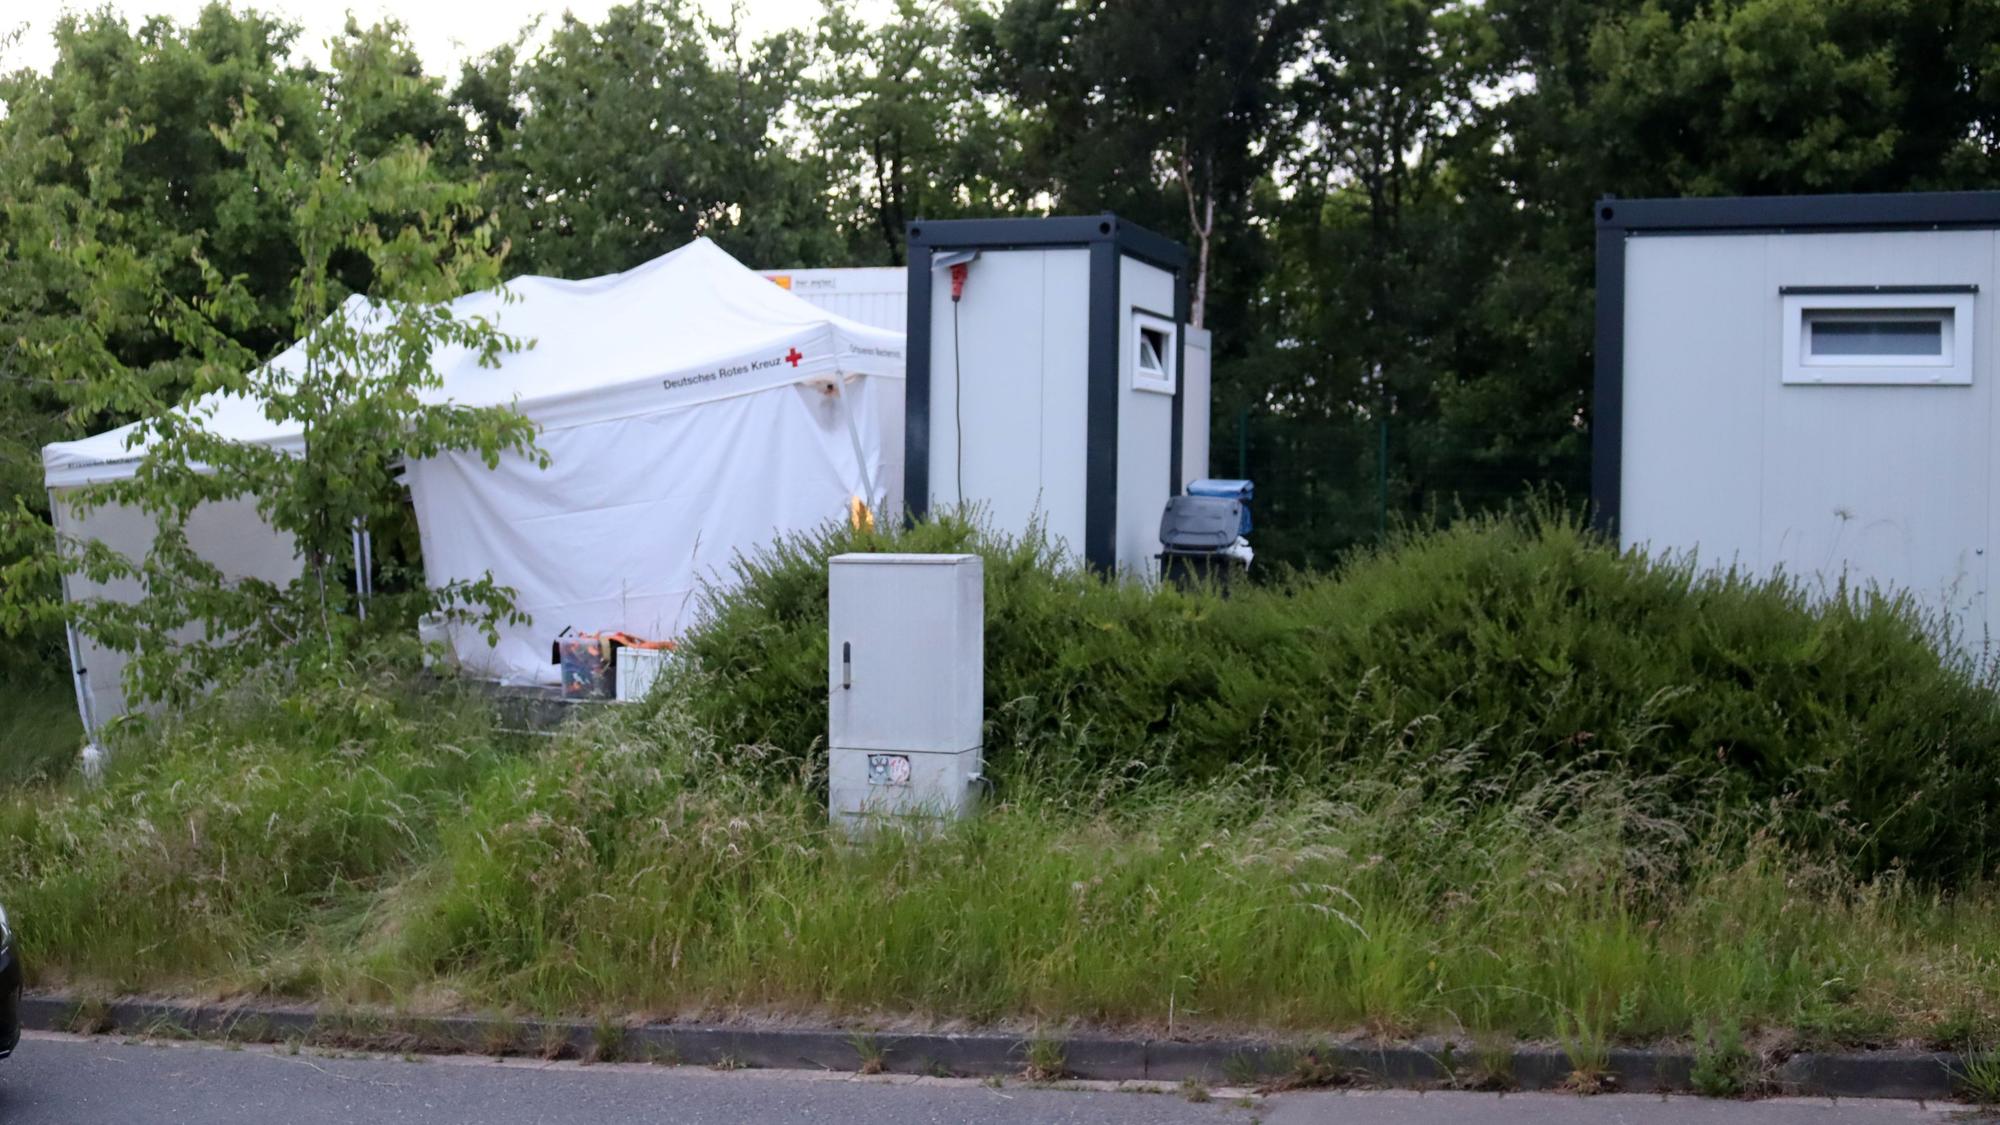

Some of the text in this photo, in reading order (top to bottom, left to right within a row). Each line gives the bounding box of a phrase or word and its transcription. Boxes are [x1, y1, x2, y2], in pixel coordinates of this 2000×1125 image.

[663, 357, 781, 390] Deutsches Rotes Kreuz
